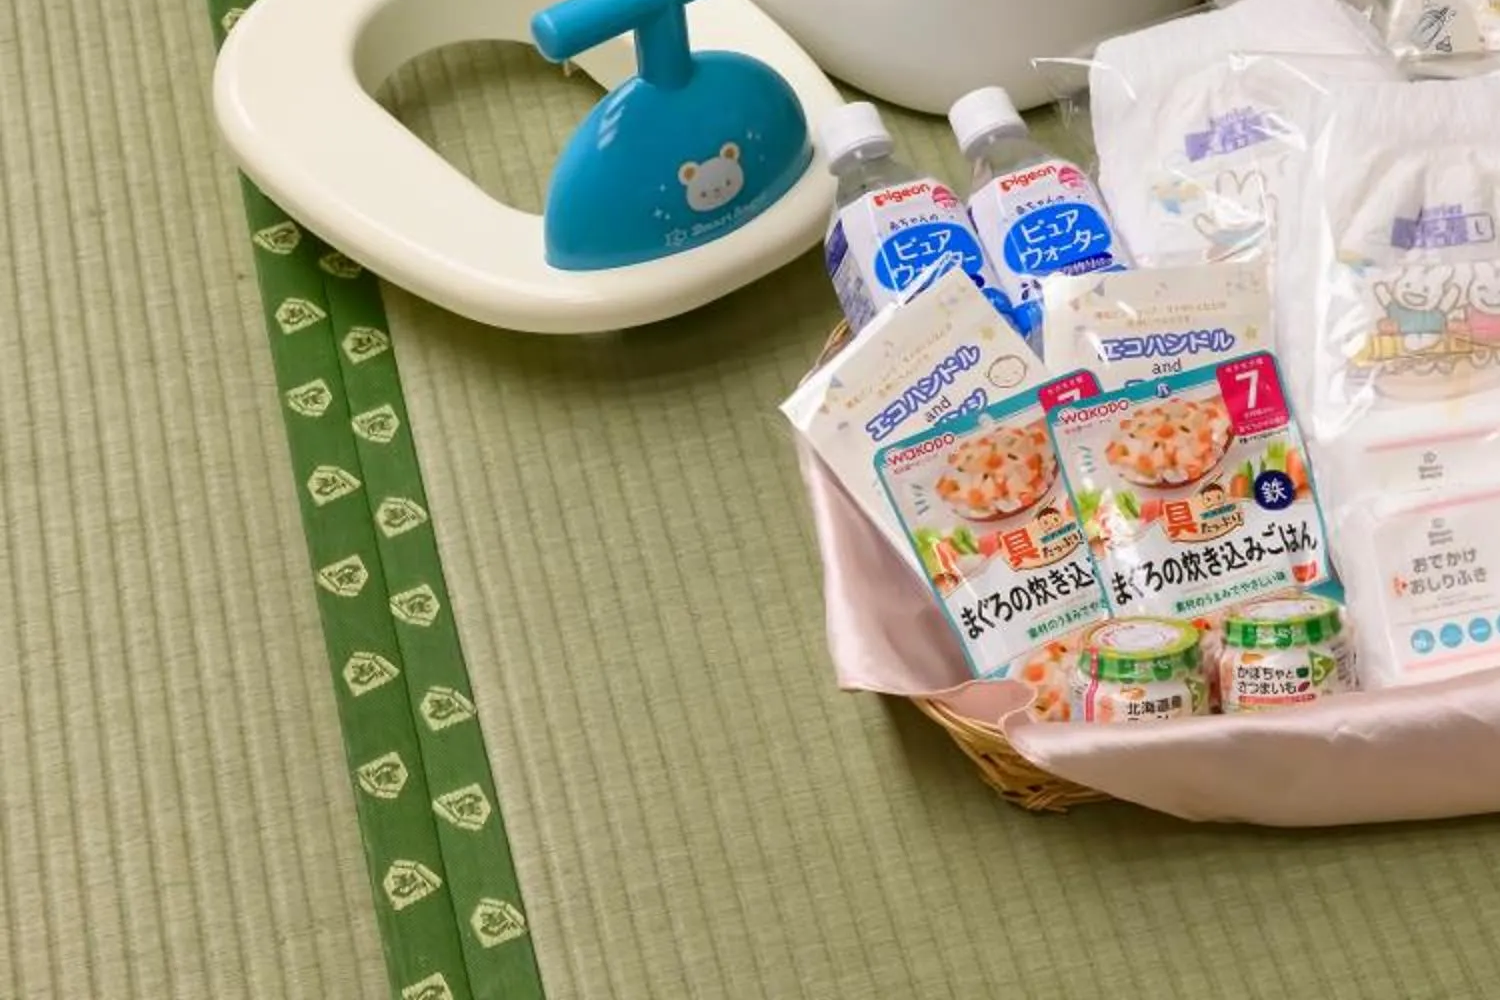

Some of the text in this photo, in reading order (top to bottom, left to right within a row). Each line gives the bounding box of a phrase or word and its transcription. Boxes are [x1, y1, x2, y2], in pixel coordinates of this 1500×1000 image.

[874, 184, 930, 206] Pigeon
[1001, 166, 1056, 192] Pigeon
[1021, 209, 1079, 244] ピュア
[893, 229, 951, 261] ピュア
[1020, 229, 1105, 268] ウォーター
[1098, 328, 1235, 360] エコハンドル
[1152, 358, 1182, 374] and
[866, 345, 981, 441] エコハンドル
[1235, 369, 1258, 409] 7
[926, 395, 952, 422] and
[1260, 478, 1288, 504] 鉄
[1165, 502, 1198, 537] 具
[1001, 527, 1040, 568] 具
[1112, 521, 1318, 605] まぐろの炊き込みごはん
[1412, 549, 1477, 573] おでかけ
[1409, 566, 1487, 595] おしりふき
[960, 557, 1097, 639] まぐろの炊き込
[1236, 666, 1294, 680] かぼちゃと
[1237, 680, 1297, 694] さつまいも
